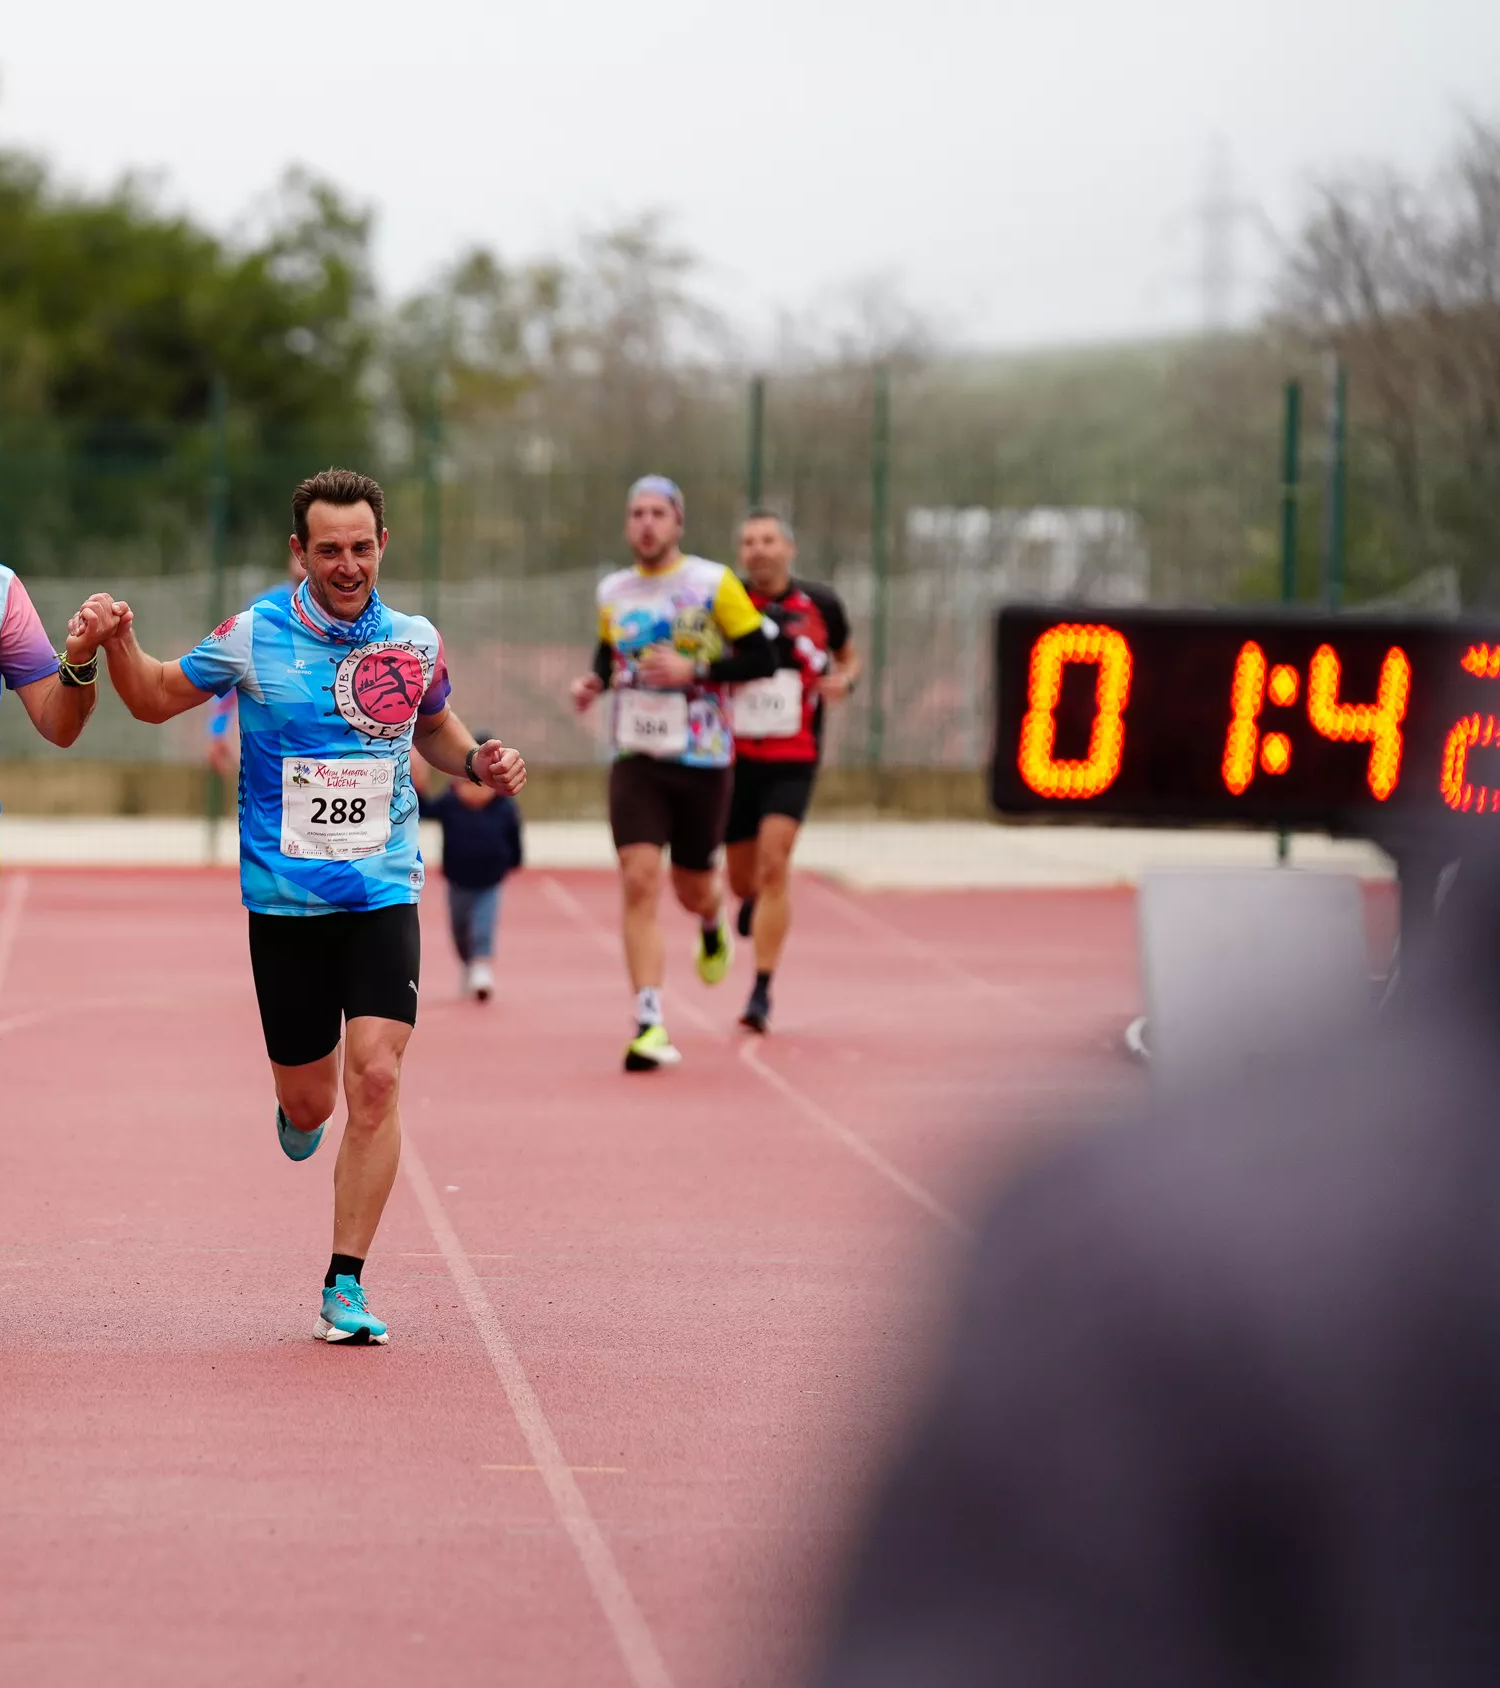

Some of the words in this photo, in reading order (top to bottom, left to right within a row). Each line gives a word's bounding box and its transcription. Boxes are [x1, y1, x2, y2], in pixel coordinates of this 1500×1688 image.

[338, 673, 356, 718] CLUB
[326, 777, 361, 788] LUCENA
[311, 797, 367, 825] 288
